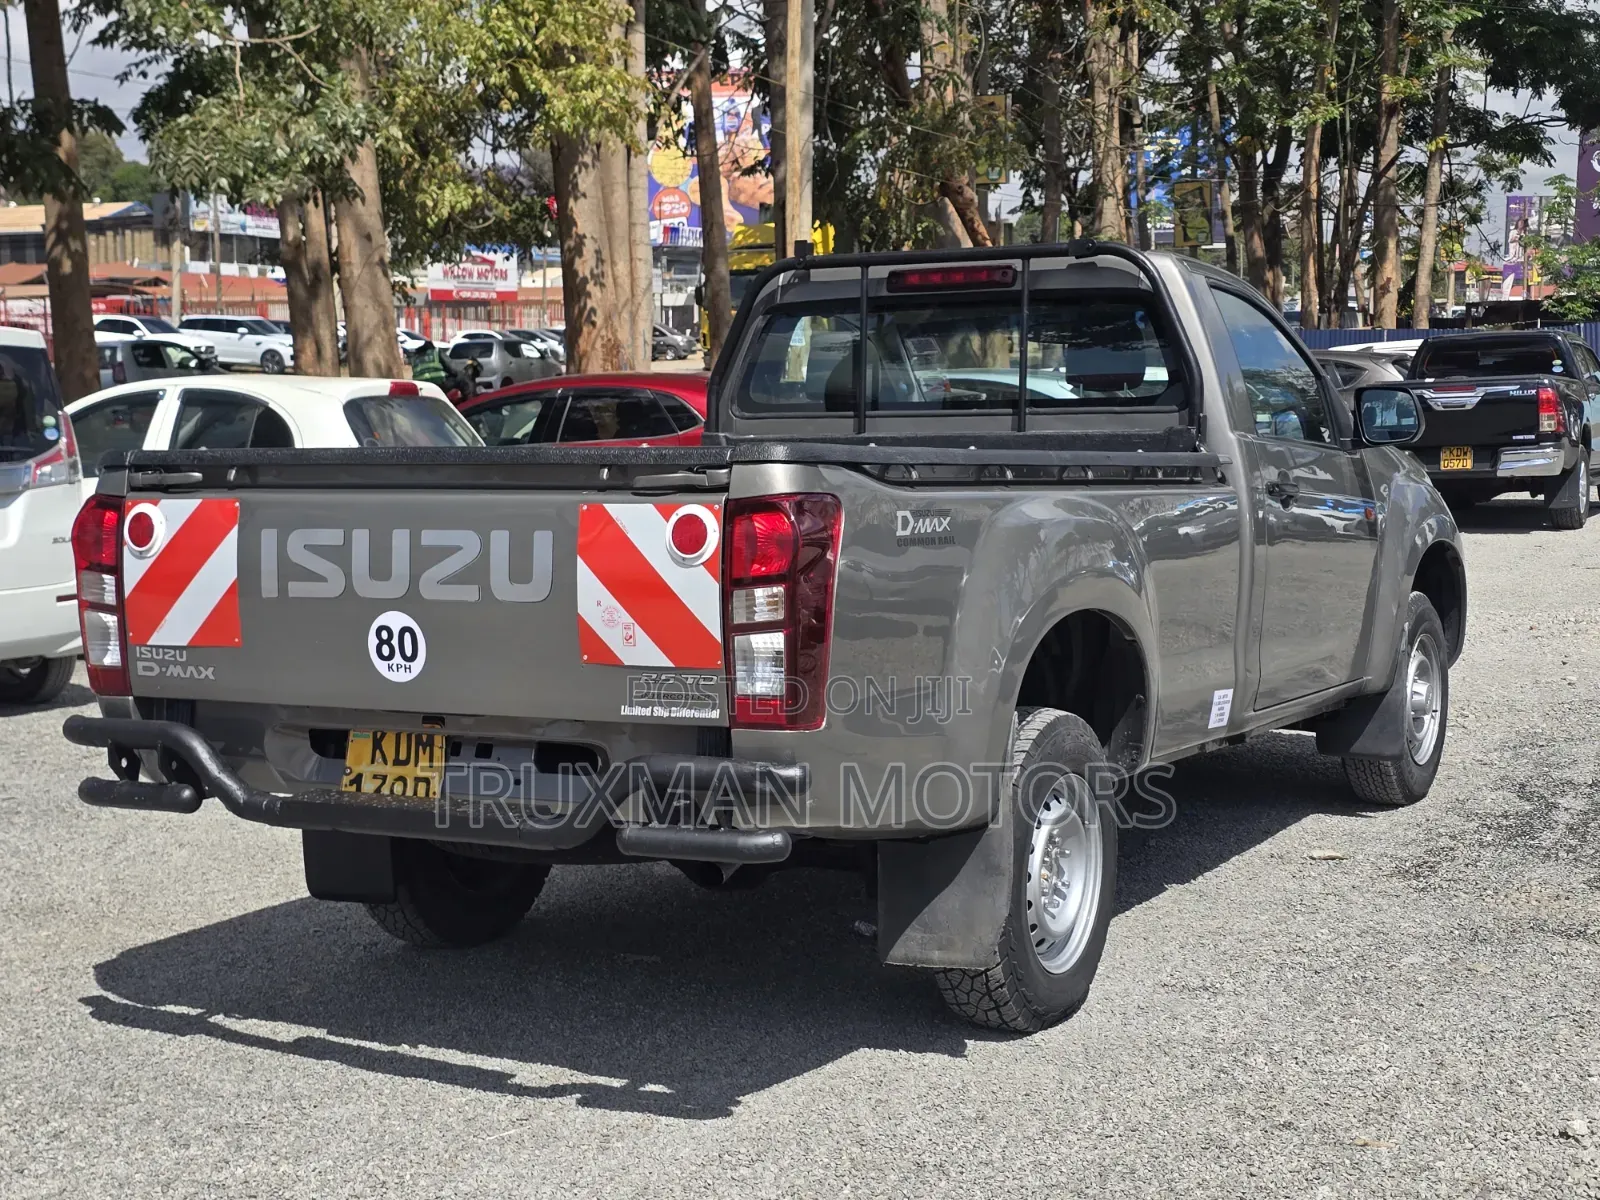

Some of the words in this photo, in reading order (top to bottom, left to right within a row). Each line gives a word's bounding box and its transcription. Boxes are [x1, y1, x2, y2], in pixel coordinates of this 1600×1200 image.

[476, 267, 508, 281] MOTORS
[1449, 447, 1469, 457] KDW
[896, 537, 936, 548] COMMON
[938, 535, 956, 545] RAIL
[261, 528, 553, 603] ISUZU
[375, 624, 418, 663] 80
[136, 646, 187, 662] ISUZU
[387, 663, 412, 674] KPH
[640, 672, 676, 684] 2.5
[680, 674, 718, 685] TD
[620, 704, 652, 716] Limited
[653, 706, 669, 718] Slip
[670, 707, 720, 719] Differential
[371, 731, 435, 768] KDM
